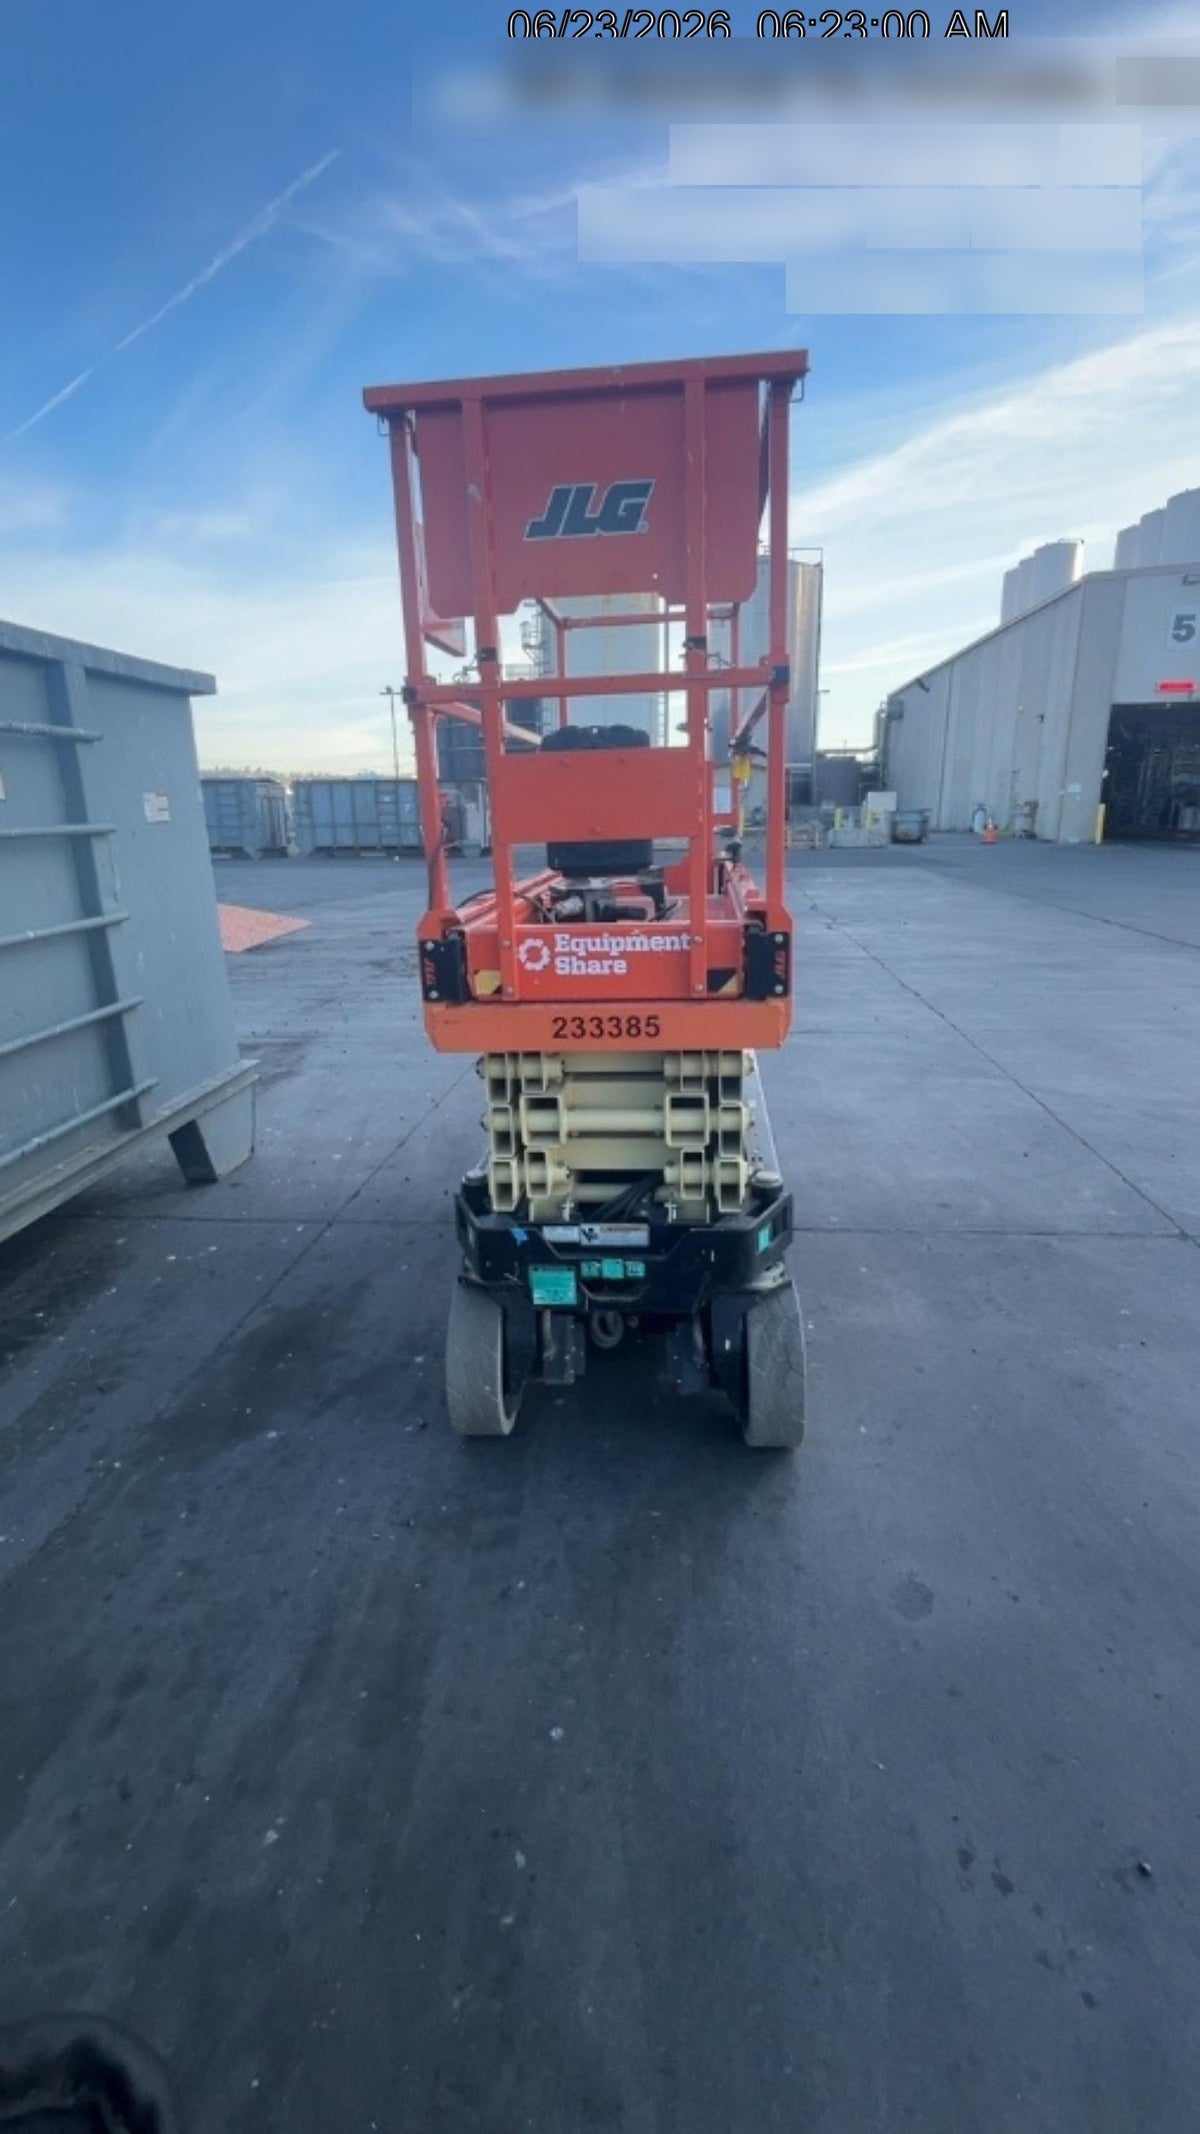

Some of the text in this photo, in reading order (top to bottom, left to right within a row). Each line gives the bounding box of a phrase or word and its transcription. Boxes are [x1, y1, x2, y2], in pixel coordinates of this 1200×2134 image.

[524, 479, 656, 541] JLG
[1171, 613, 1196, 643] 5
[554, 933, 691, 956] Equipment
[554, 955, 627, 975] Share
[552, 1015, 661, 1040] 233385
